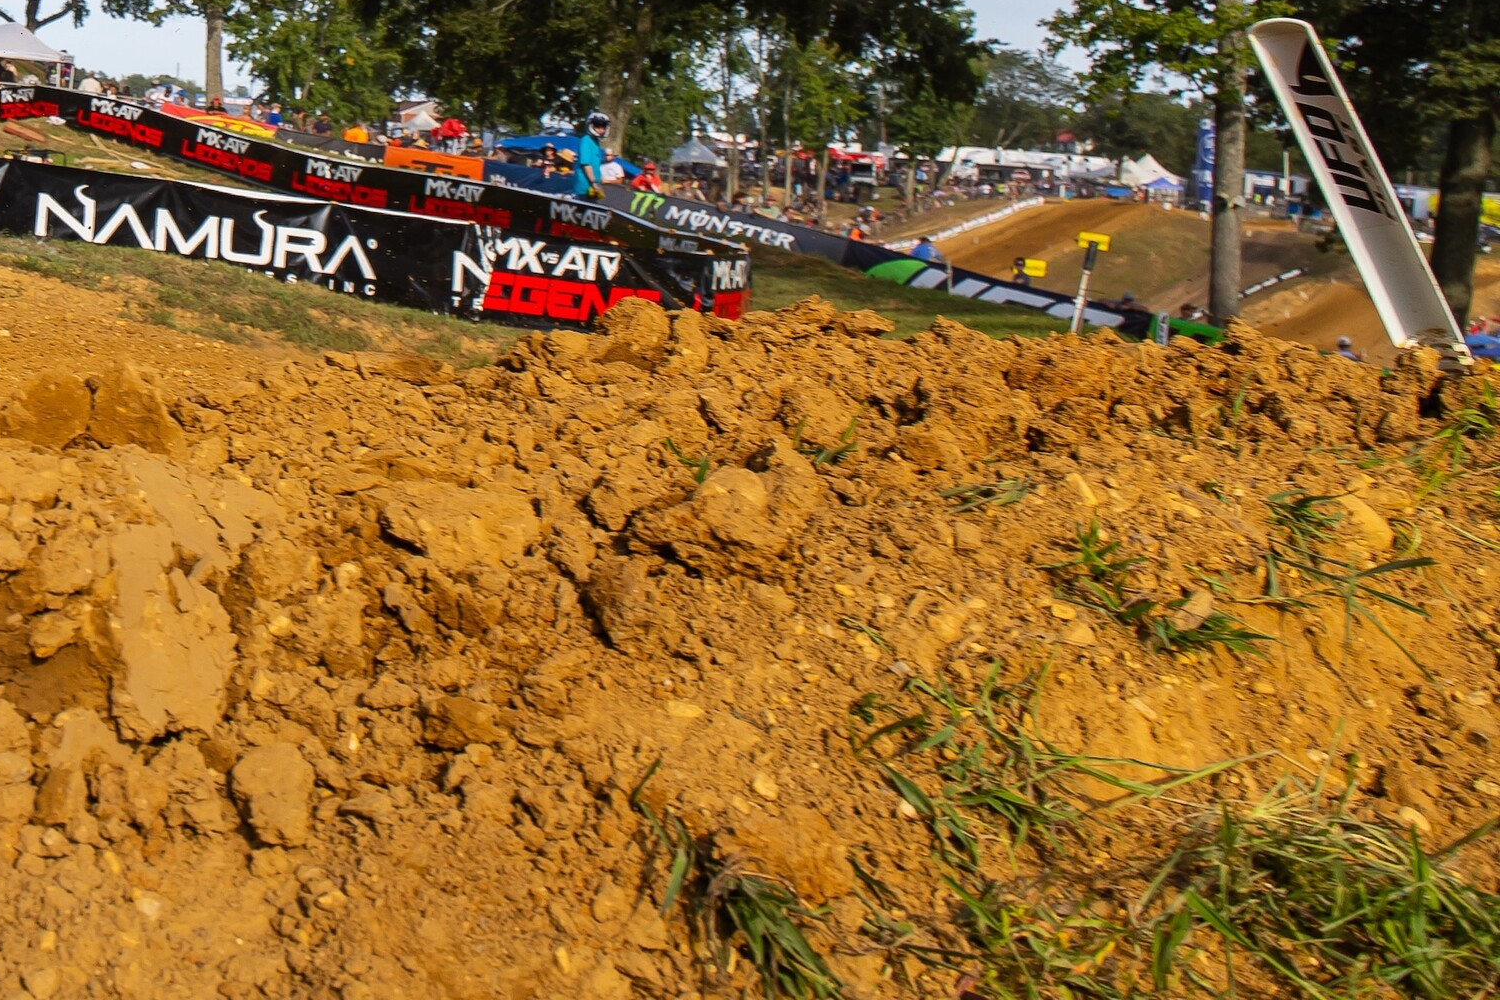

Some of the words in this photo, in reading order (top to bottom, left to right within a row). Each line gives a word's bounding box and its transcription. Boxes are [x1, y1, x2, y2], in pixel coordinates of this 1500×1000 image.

[33, 184, 378, 281] NAMURA
[551, 245, 622, 282] ATV
[328, 278, 377, 297] INC
